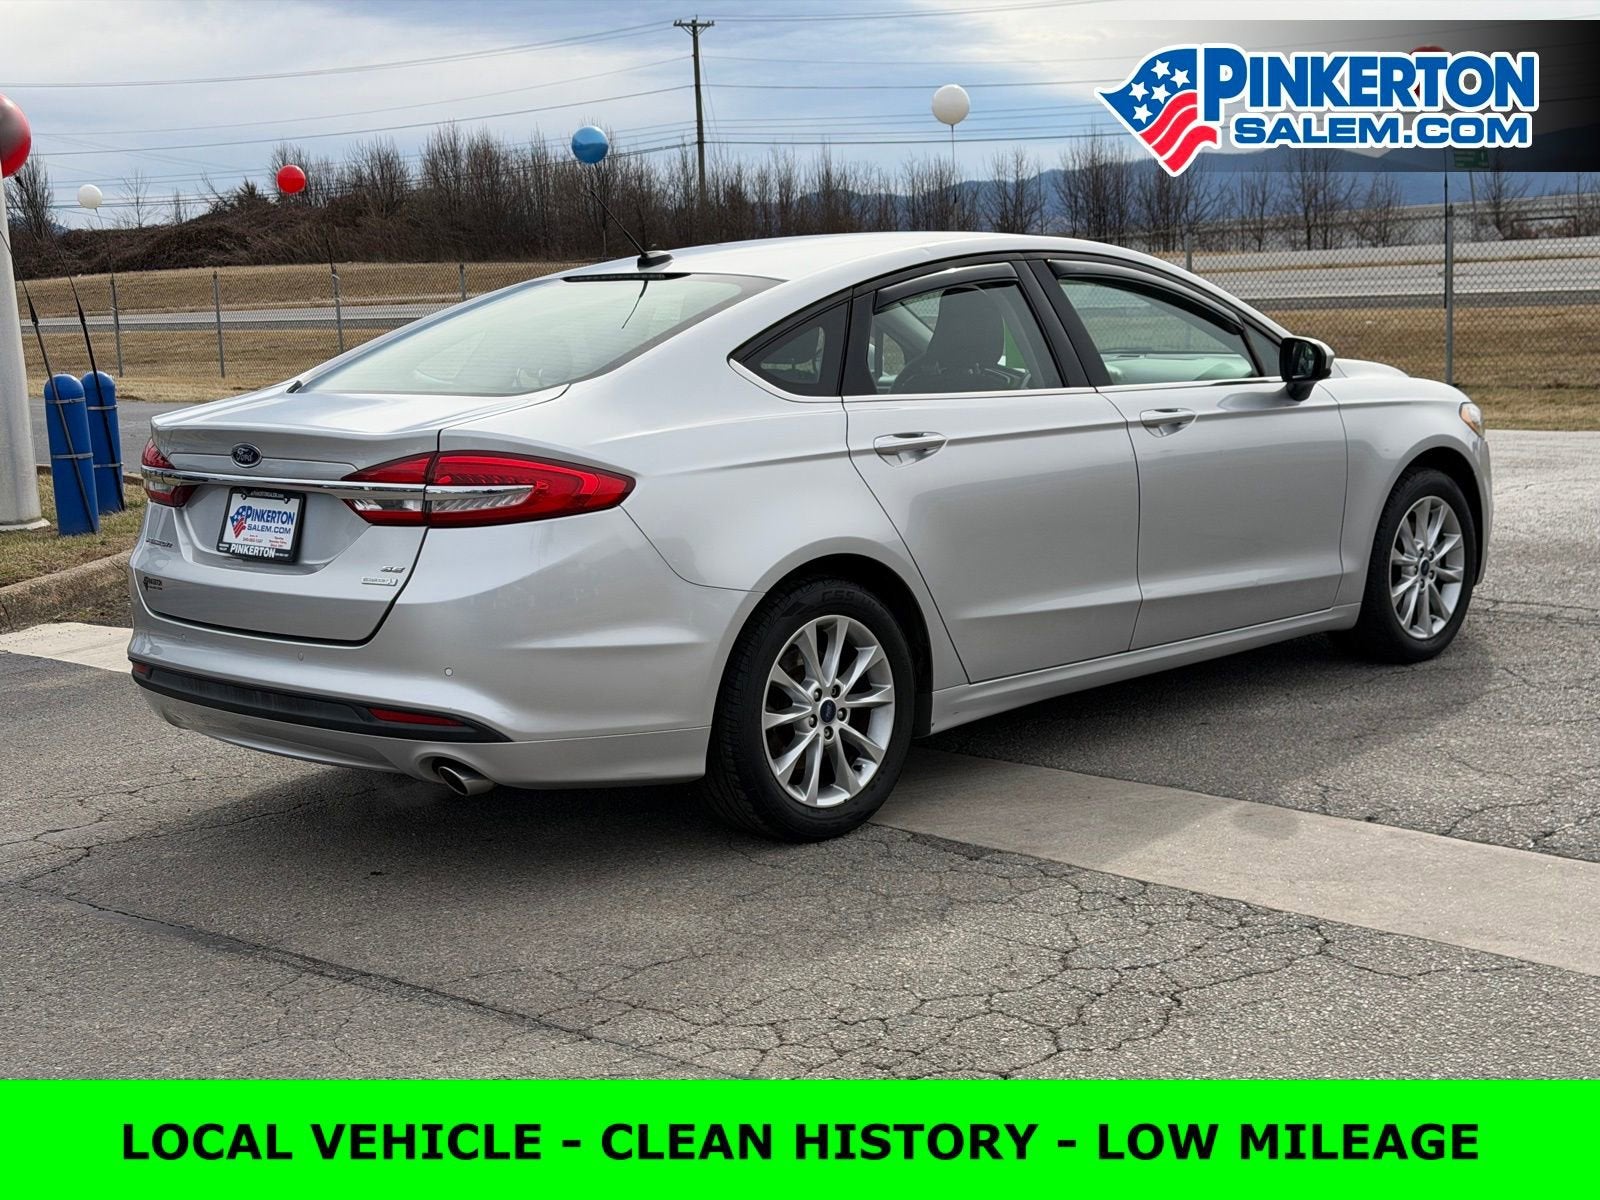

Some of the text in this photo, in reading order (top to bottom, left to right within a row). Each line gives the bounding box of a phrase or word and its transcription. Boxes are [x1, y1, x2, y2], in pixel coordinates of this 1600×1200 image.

[245, 505, 295, 526] PINKERTON
[247, 523, 292, 535] SALEM.COM
[229, 543, 277, 559] PINKERTON
